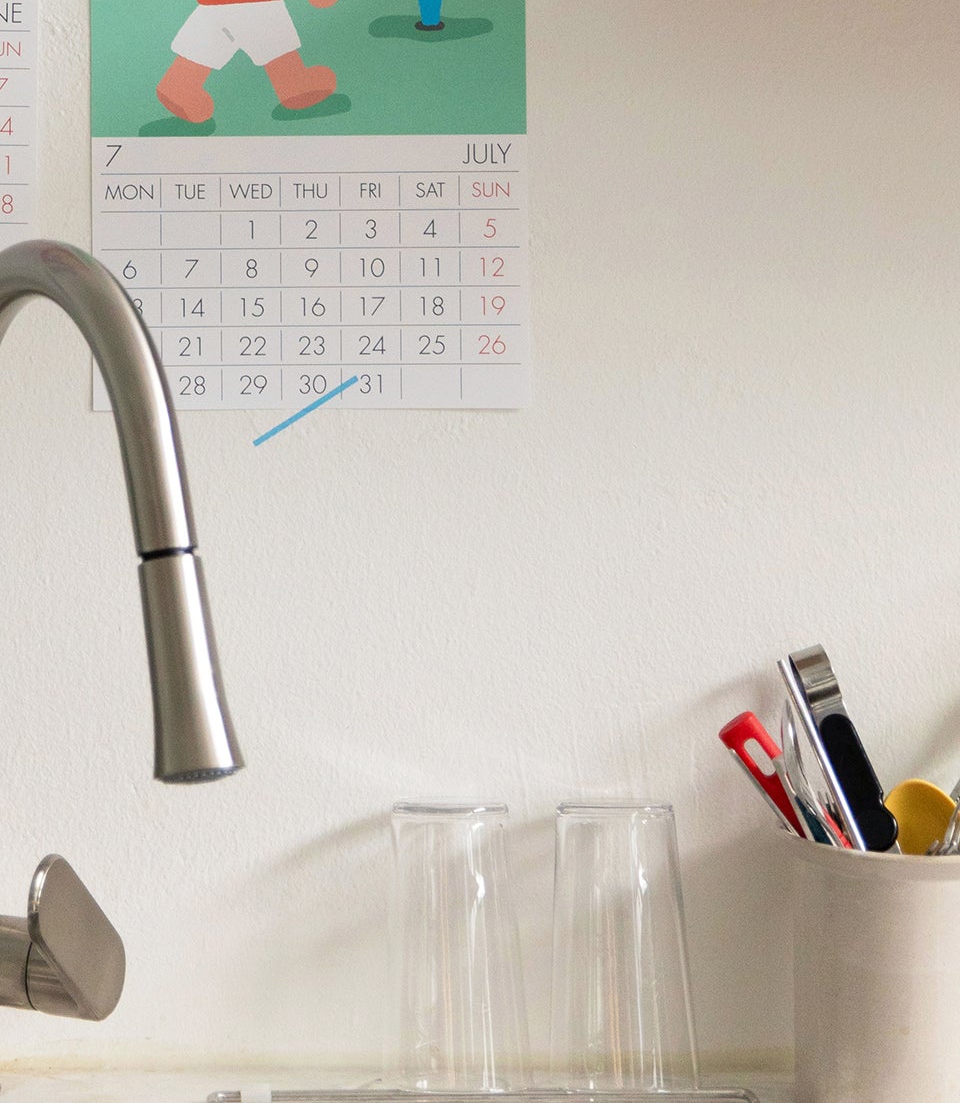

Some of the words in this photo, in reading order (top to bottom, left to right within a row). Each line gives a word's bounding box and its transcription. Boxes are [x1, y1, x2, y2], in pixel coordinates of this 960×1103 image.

[105, 144, 123, 168] 7
[462, 142, 512, 165] JULY
[104, 184, 154, 201] MON
[174, 183, 206, 200] TUE
[228, 183, 273, 200] WED
[292, 182, 328, 199] THU
[359, 182, 381, 199] FRI
[415, 181, 446, 199] SAT
[471, 181, 511, 198] SUN
[248, 219, 254, 240] 1
[305, 219, 318, 240] 2
[365, 218, 377, 240] 3
[422, 218, 438, 239] 4
[483, 217, 497, 239] 5
[122, 259, 138, 280] 6
[184, 258, 200, 279] 7
[245, 258, 258, 279] 8
[304, 257, 319, 278] 9
[359, 257, 386, 278] 10
[419, 257, 440, 278] 11
[480, 256, 505, 278] 12
[180, 297, 206, 318] 14
[240, 297, 265, 318] 15
[300, 296, 326, 317] 16
[360, 296, 386, 317] 17
[420, 295, 445, 317] 18
[480, 295, 506, 316] 19
[178, 336, 202, 357] 21
[239, 335, 267, 357] 22
[298, 335, 326, 356] 23
[358, 335, 387, 356] 24
[418, 334, 446, 355] 25
[477, 334, 507, 355] 26
[178, 375, 207, 395] 28
[239, 374, 268, 395] 29
[298, 374, 327, 395] 30
[359, 373, 384, 394] 31
